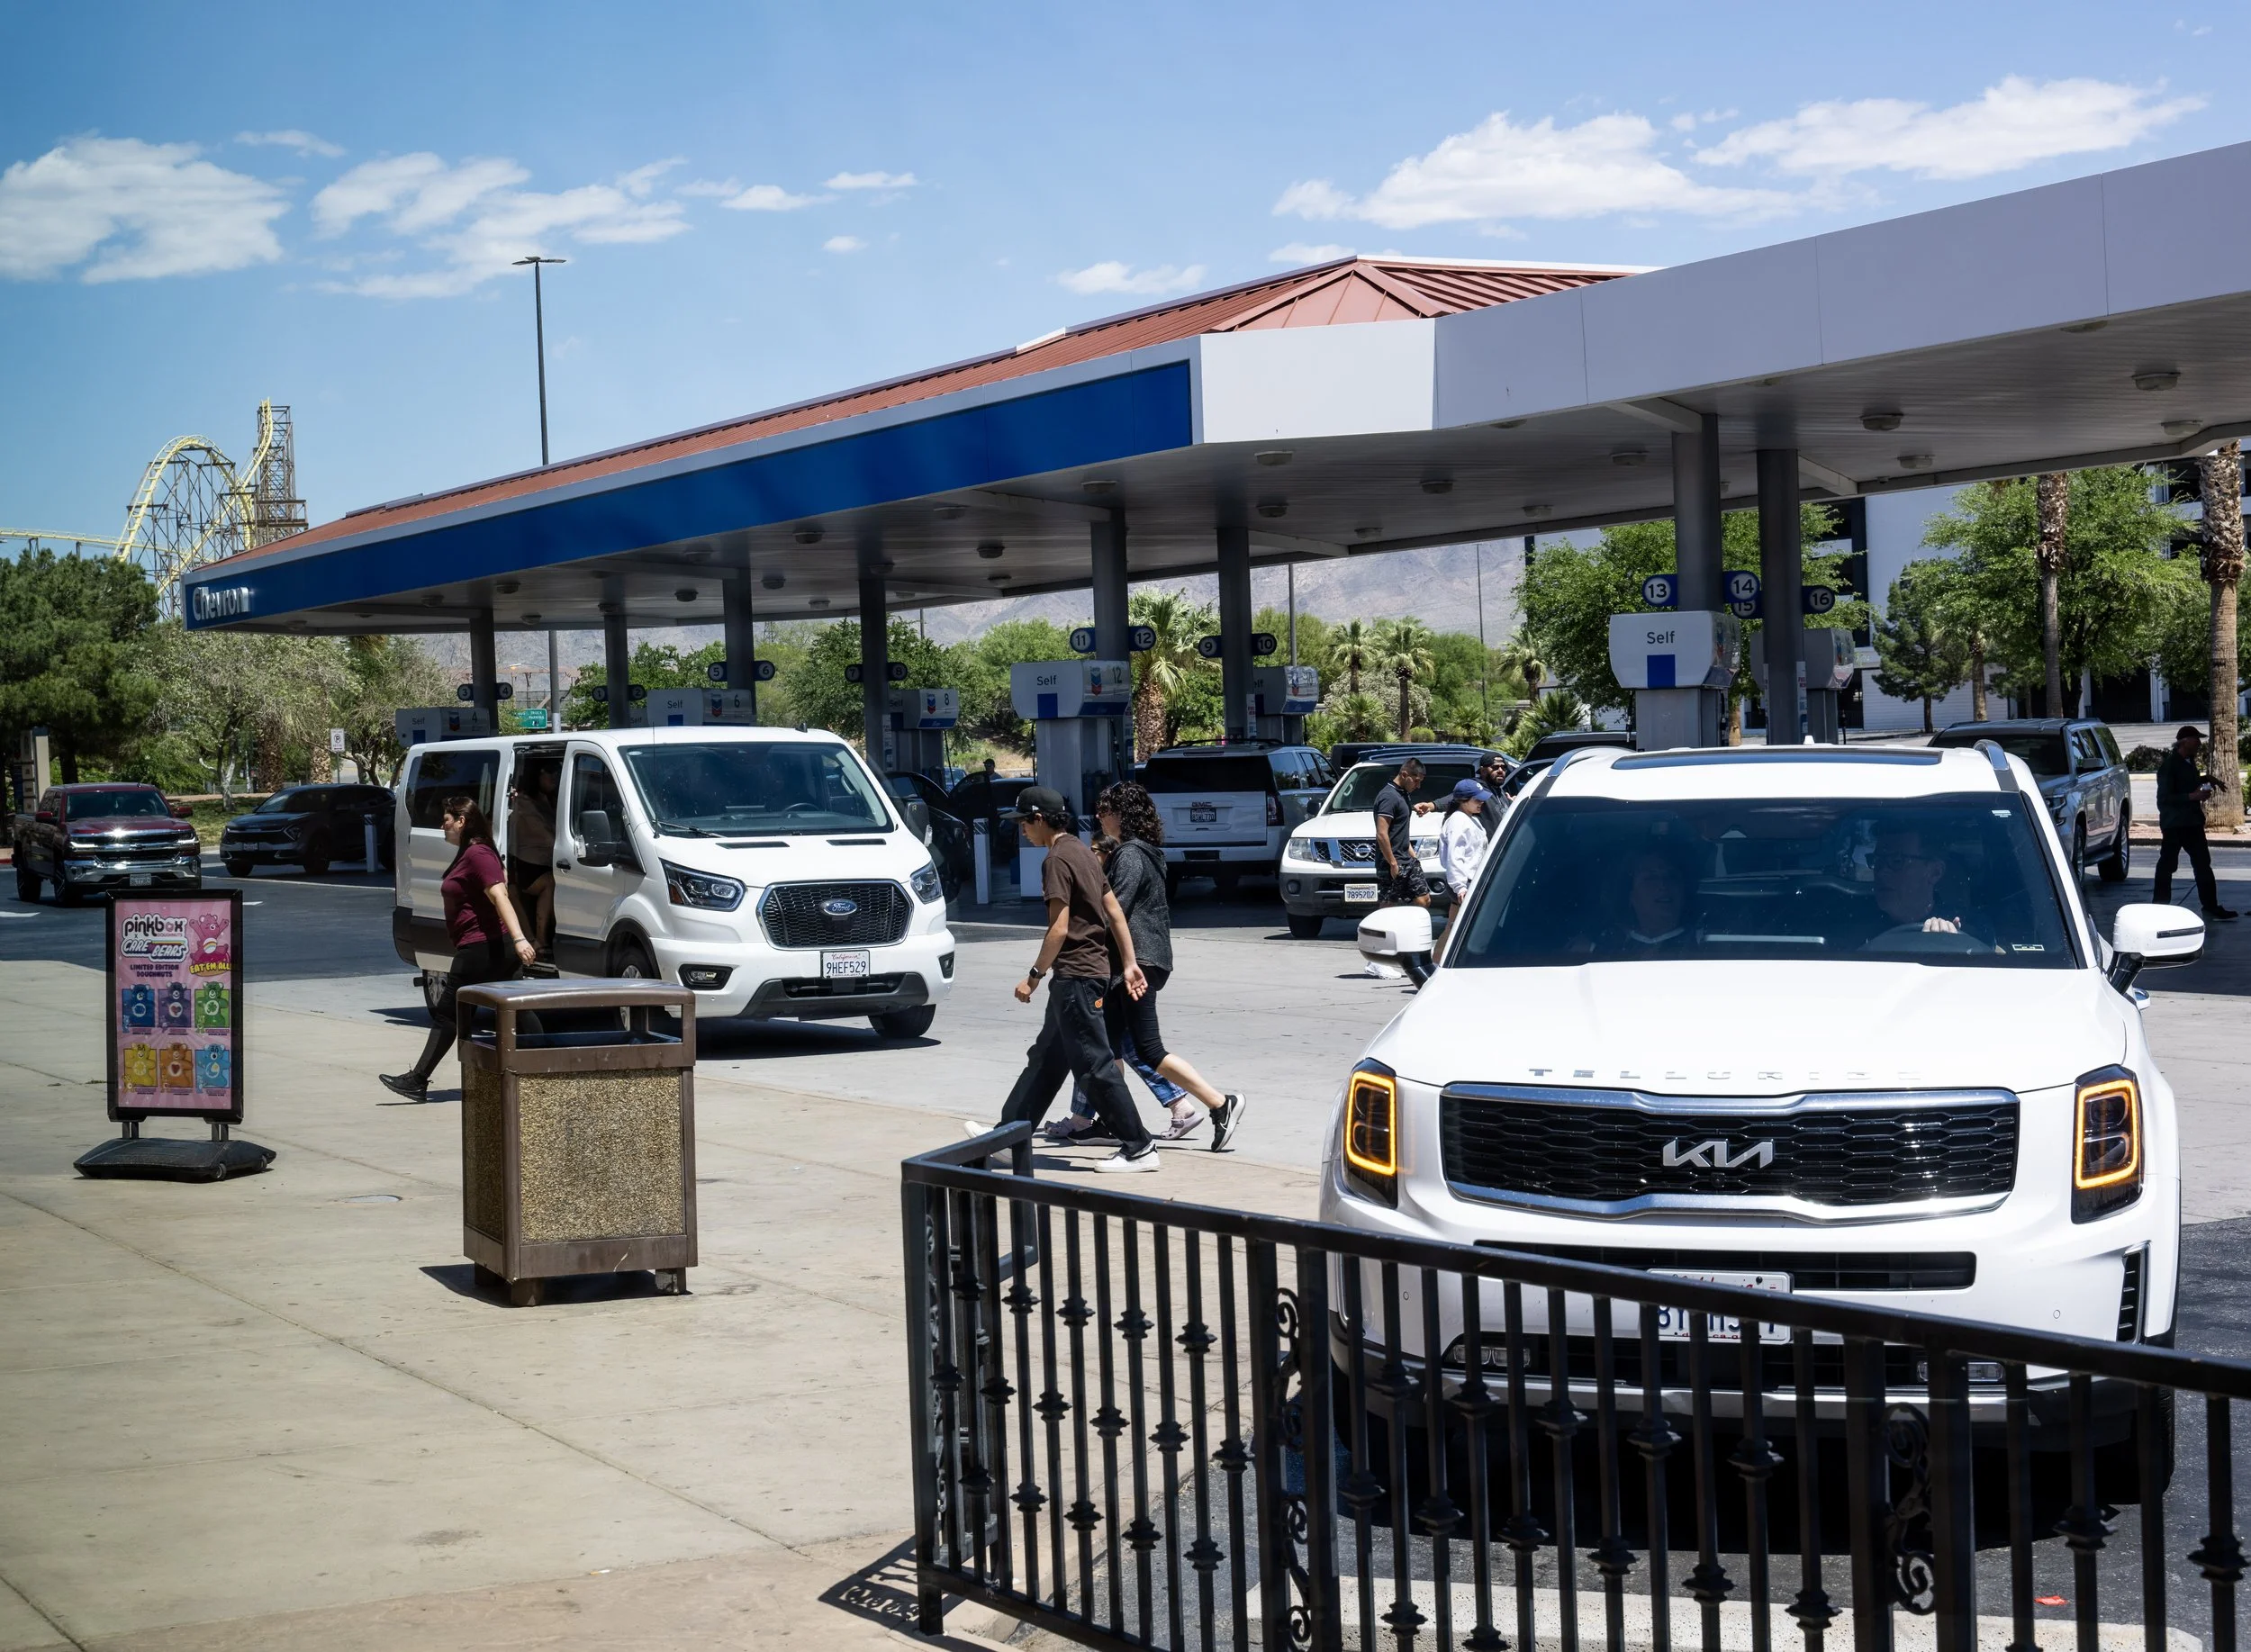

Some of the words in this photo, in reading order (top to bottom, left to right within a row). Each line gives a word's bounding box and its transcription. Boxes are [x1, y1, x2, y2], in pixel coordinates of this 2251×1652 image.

[1648, 583, 1668, 599] 13
[1733, 579, 1754, 594] 14
[193, 586, 249, 621] Chevron
[1813, 592, 1831, 606] 16
[1737, 600, 1753, 612] 15
[1075, 634, 1086, 646] 11
[1137, 632, 1152, 645] 12
[1260, 638, 1273, 650] 10
[1647, 631, 1676, 645] Self
[1204, 641, 1213, 652] 9
[713, 667, 720, 677] 5
[763, 665, 770, 675] 6
[849, 669, 855, 677] 7
[1112, 666, 1123, 684] 12
[1036, 675, 1057, 686] Self
[462, 689, 468, 697] 3
[945, 693, 950, 706] 8
[666, 700, 683, 709] Self
[734, 695, 740, 709] 6
[471, 711, 478, 724] 4
[832, 903, 851, 912] Ford
[125, 916, 183, 937] pinkbox
[123, 939, 151, 952] CARE
[152, 944, 185, 957] BEARS
[190, 963, 204, 974] EAT
[827, 961, 866, 974] 9HEF529
